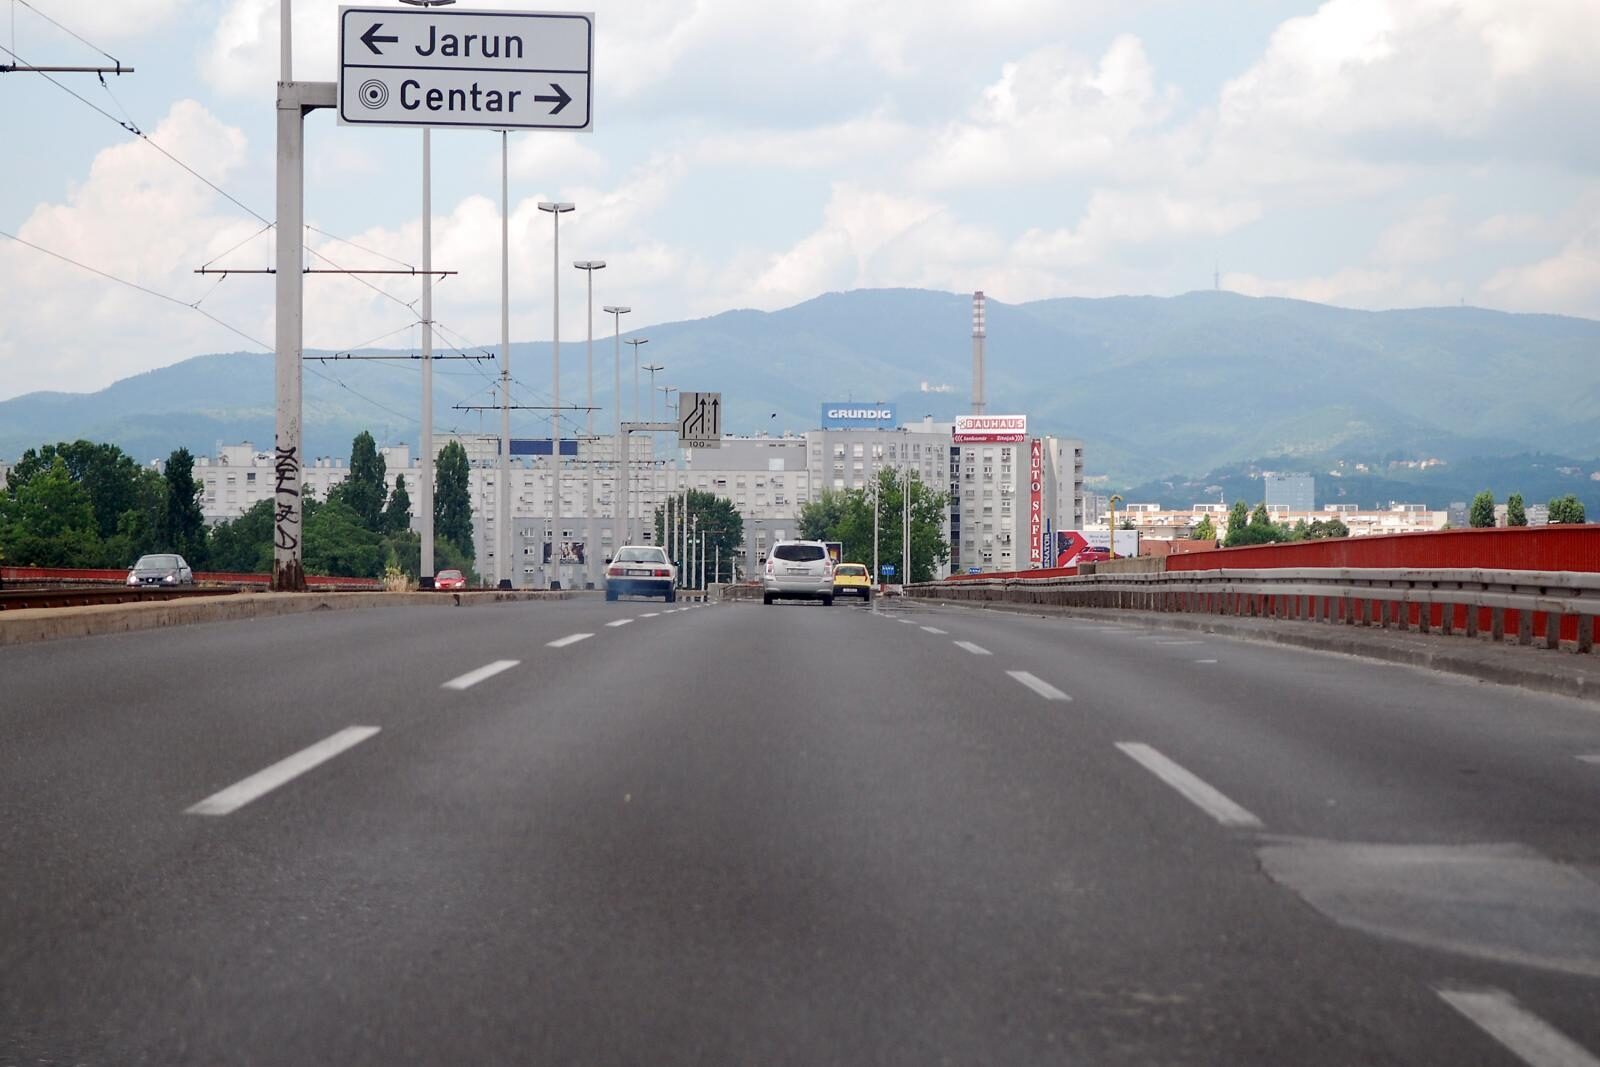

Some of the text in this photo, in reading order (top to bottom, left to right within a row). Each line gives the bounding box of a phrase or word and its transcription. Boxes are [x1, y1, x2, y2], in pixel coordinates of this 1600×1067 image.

[415, 25, 523, 58] Jarun
[400, 79, 522, 113] Centar
[828, 409, 891, 419] GRUNDIG
[966, 419, 1024, 429] BAUHAUS
[1031, 446, 1040, 559] AUTO SAFIR
